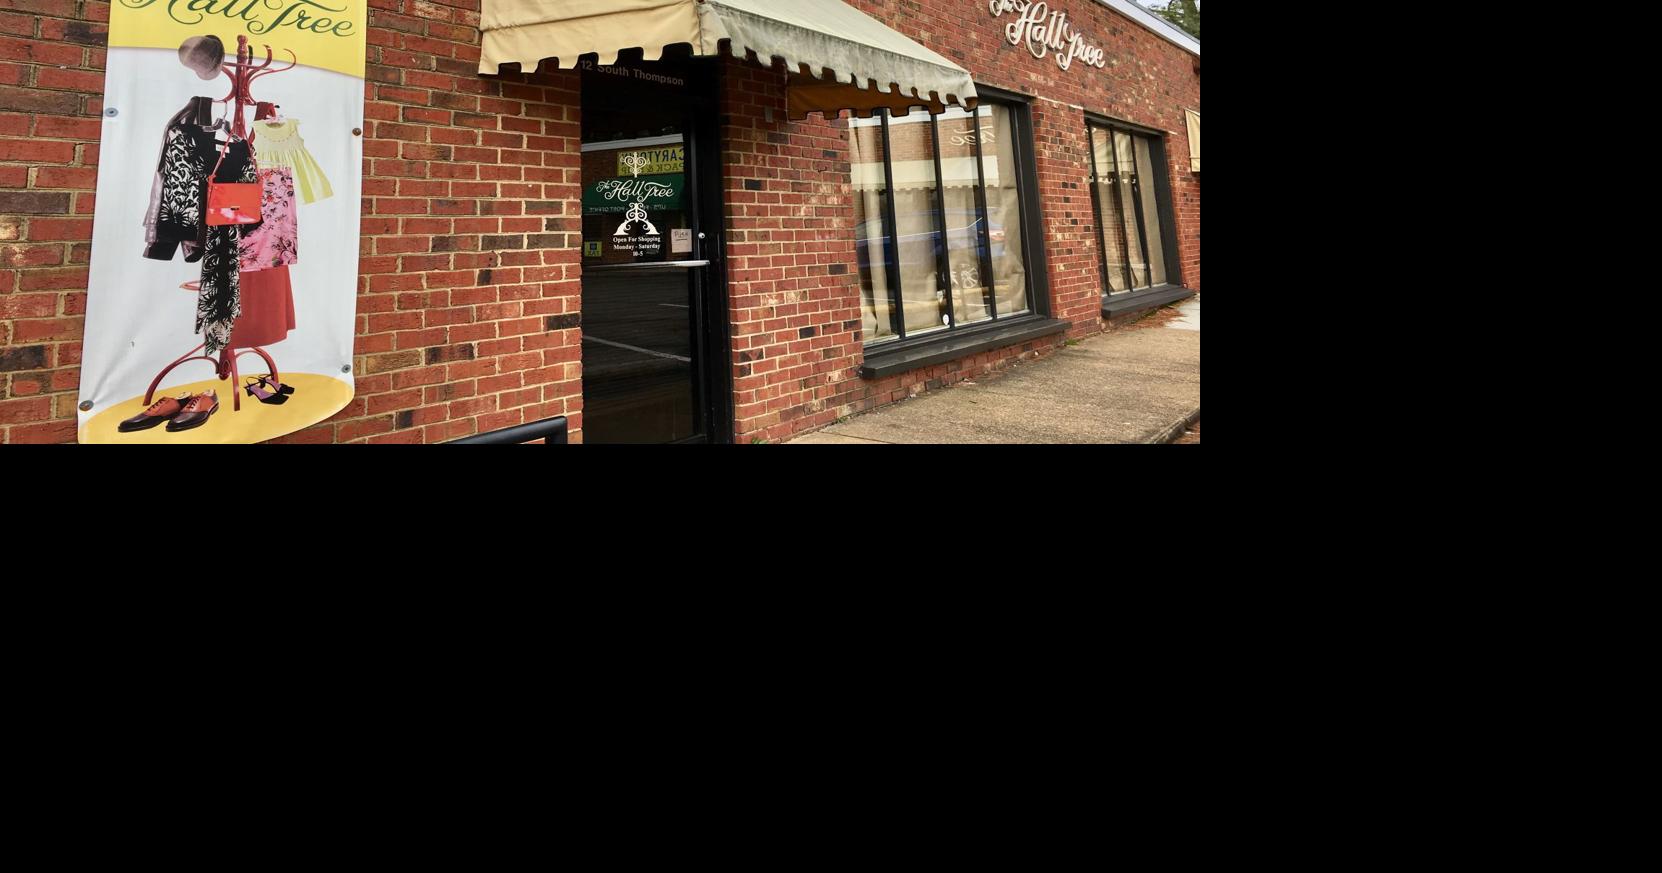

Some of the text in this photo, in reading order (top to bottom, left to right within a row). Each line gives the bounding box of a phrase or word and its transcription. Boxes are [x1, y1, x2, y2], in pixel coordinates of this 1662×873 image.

[247, 0, 356, 36] Tree
[1005, 0, 1066, 59] Hall
[1055, 22, 1106, 71] Tree
[633, 68, 684, 86] Thompson
[604, 179, 645, 202] Hall
[637, 181, 674, 203] Tree
